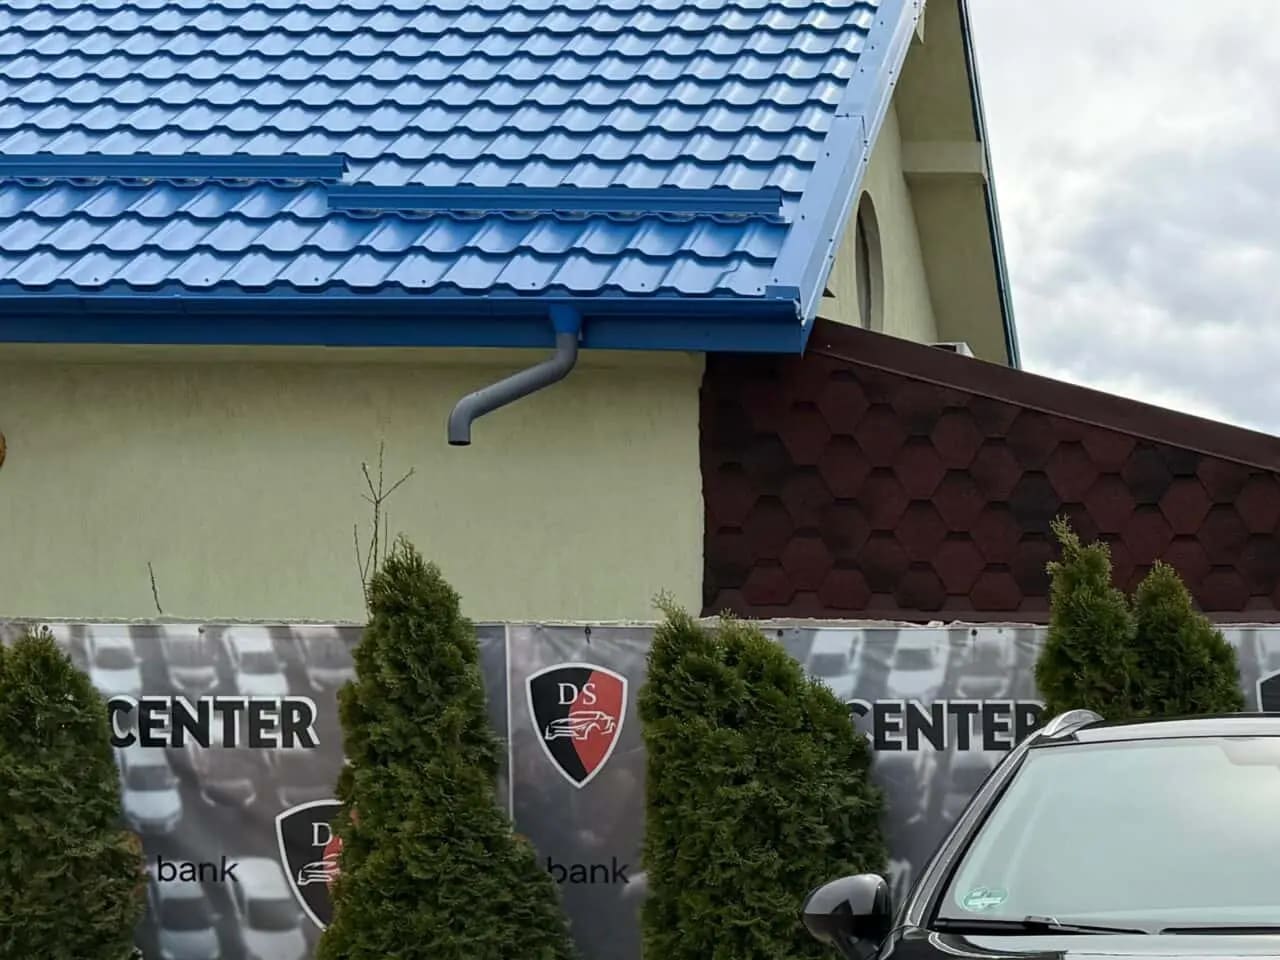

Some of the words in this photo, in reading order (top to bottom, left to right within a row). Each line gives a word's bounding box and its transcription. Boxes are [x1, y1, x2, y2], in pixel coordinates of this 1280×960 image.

[557, 682, 597, 706] DS
[107, 696, 320, 749] CENTER
[157, 856, 239, 883] bank
